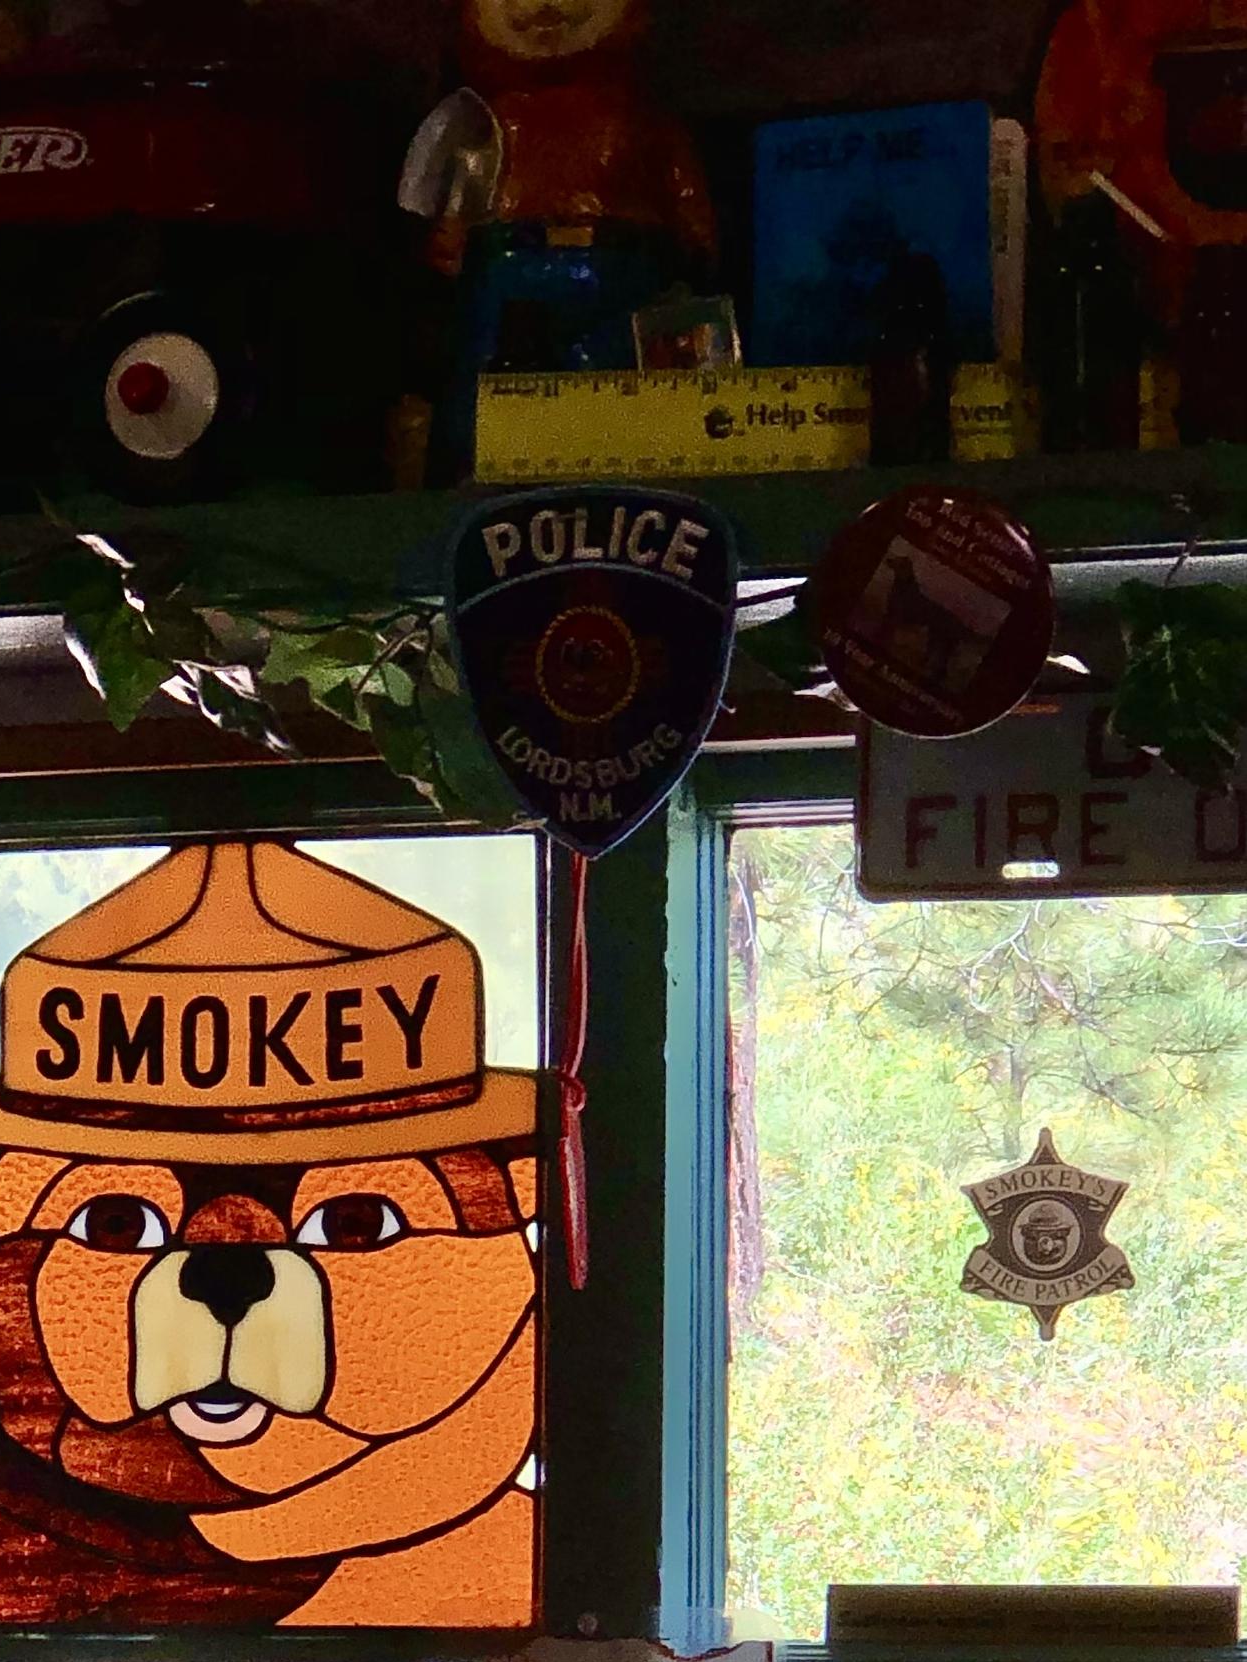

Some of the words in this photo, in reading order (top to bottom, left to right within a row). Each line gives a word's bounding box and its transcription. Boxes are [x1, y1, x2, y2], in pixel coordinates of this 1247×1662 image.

[746, 402, 806, 432] Help
[481, 505, 711, 581] POLICE
[497, 723, 683, 791] LORDSBURG
[904, 791, 1129, 869] FIRE
[35, 975, 440, 1088] SMOKEY
[984, 1169, 1107, 1201] SMOKEY'S
[979, 1260, 1028, 1298] FIRE
[1034, 1256, 1115, 1301] PATROL
